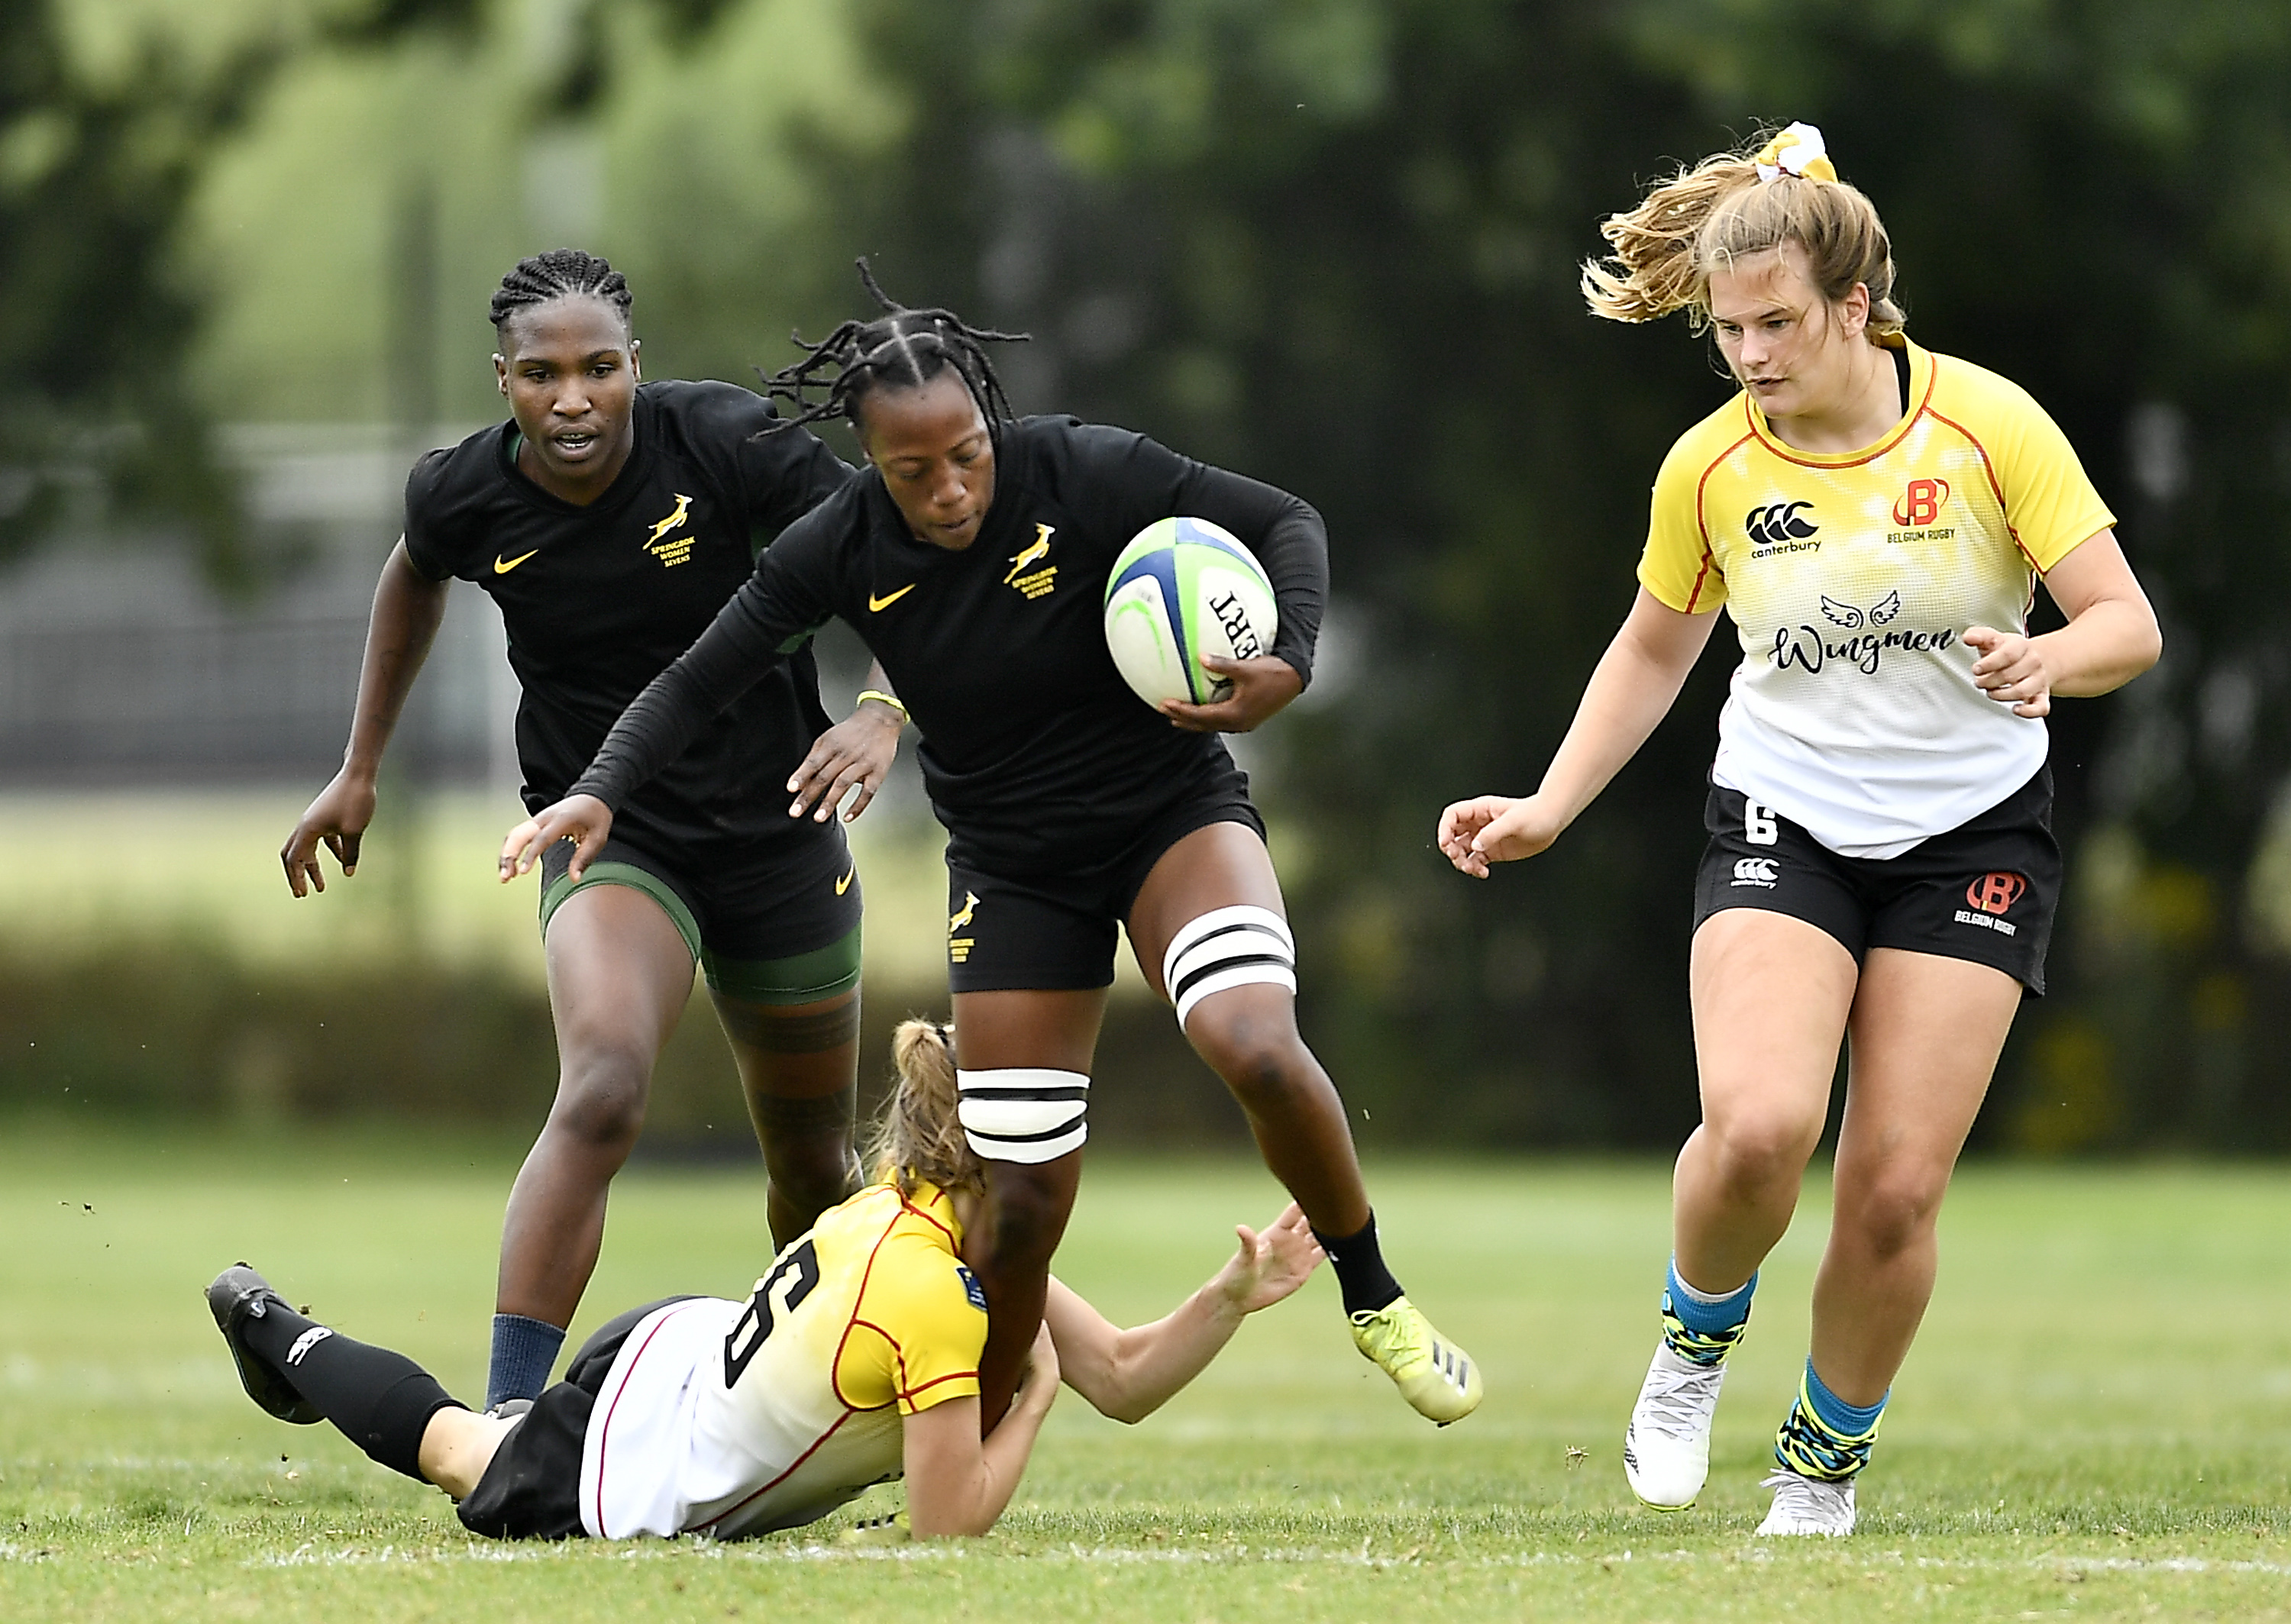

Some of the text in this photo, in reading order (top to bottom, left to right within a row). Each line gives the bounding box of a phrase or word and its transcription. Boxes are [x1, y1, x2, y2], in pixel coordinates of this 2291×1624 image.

[651, 535, 696, 555] SPRINGBOK
[1751, 540, 1821, 559] canterbury
[1887, 528, 1955, 544] BELGIUM RUGBY
[1767, 625, 1957, 674] Wingmen
[1745, 798, 1778, 845] 6
[725, 1239, 819, 1389] 6
